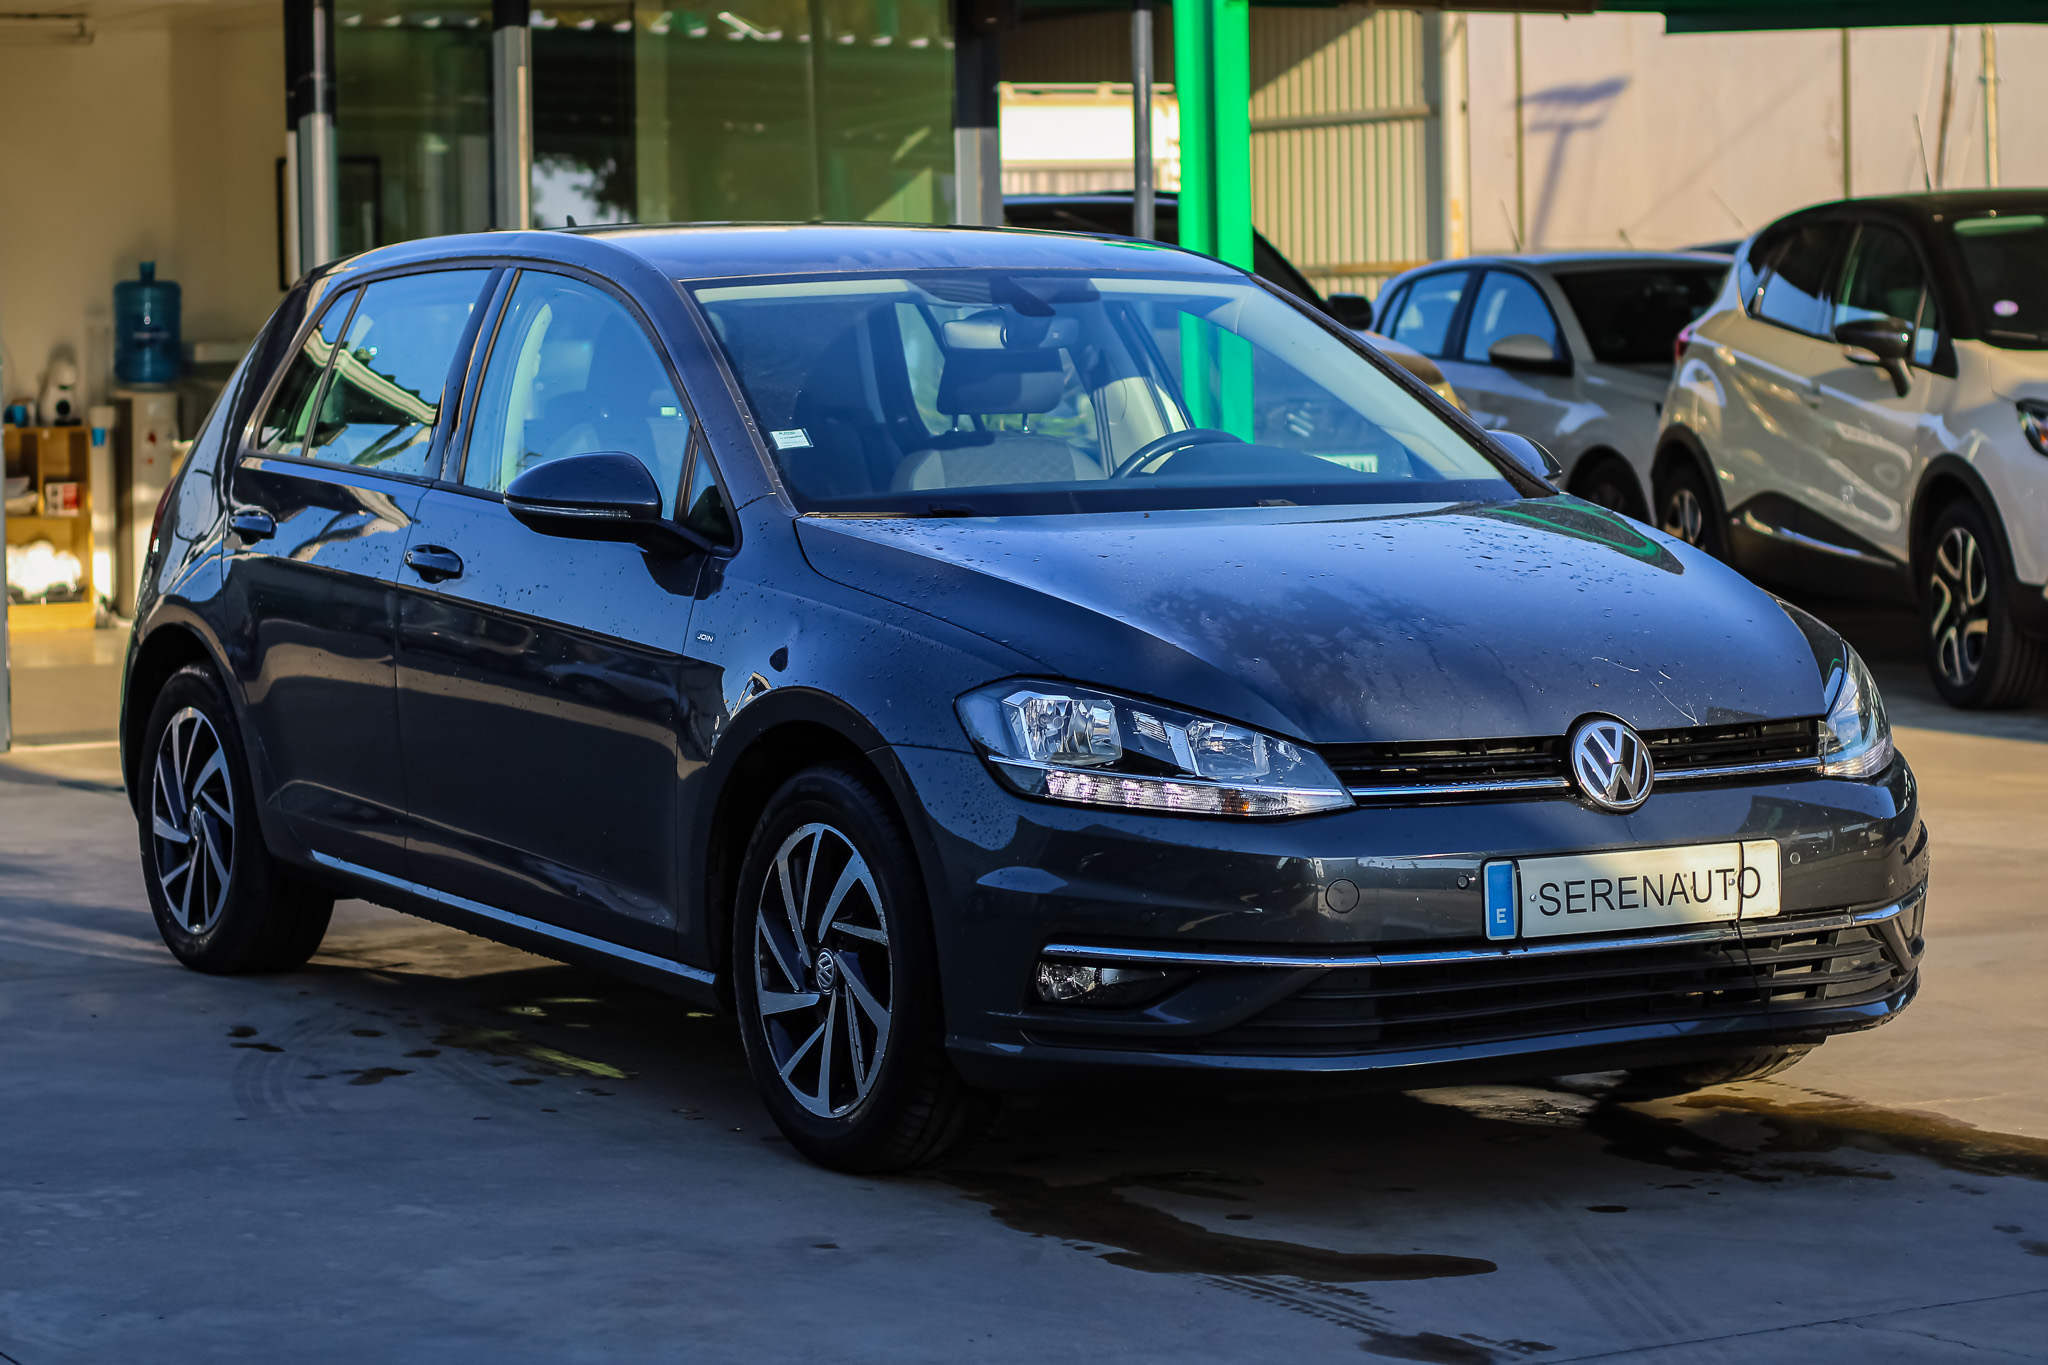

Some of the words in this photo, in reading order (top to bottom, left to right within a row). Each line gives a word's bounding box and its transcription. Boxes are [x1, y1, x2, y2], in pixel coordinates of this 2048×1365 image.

[697, 633, 714, 642] JOIN
[1538, 866, 1761, 916] SERENAUTO
[1496, 908, 1507, 924] E
